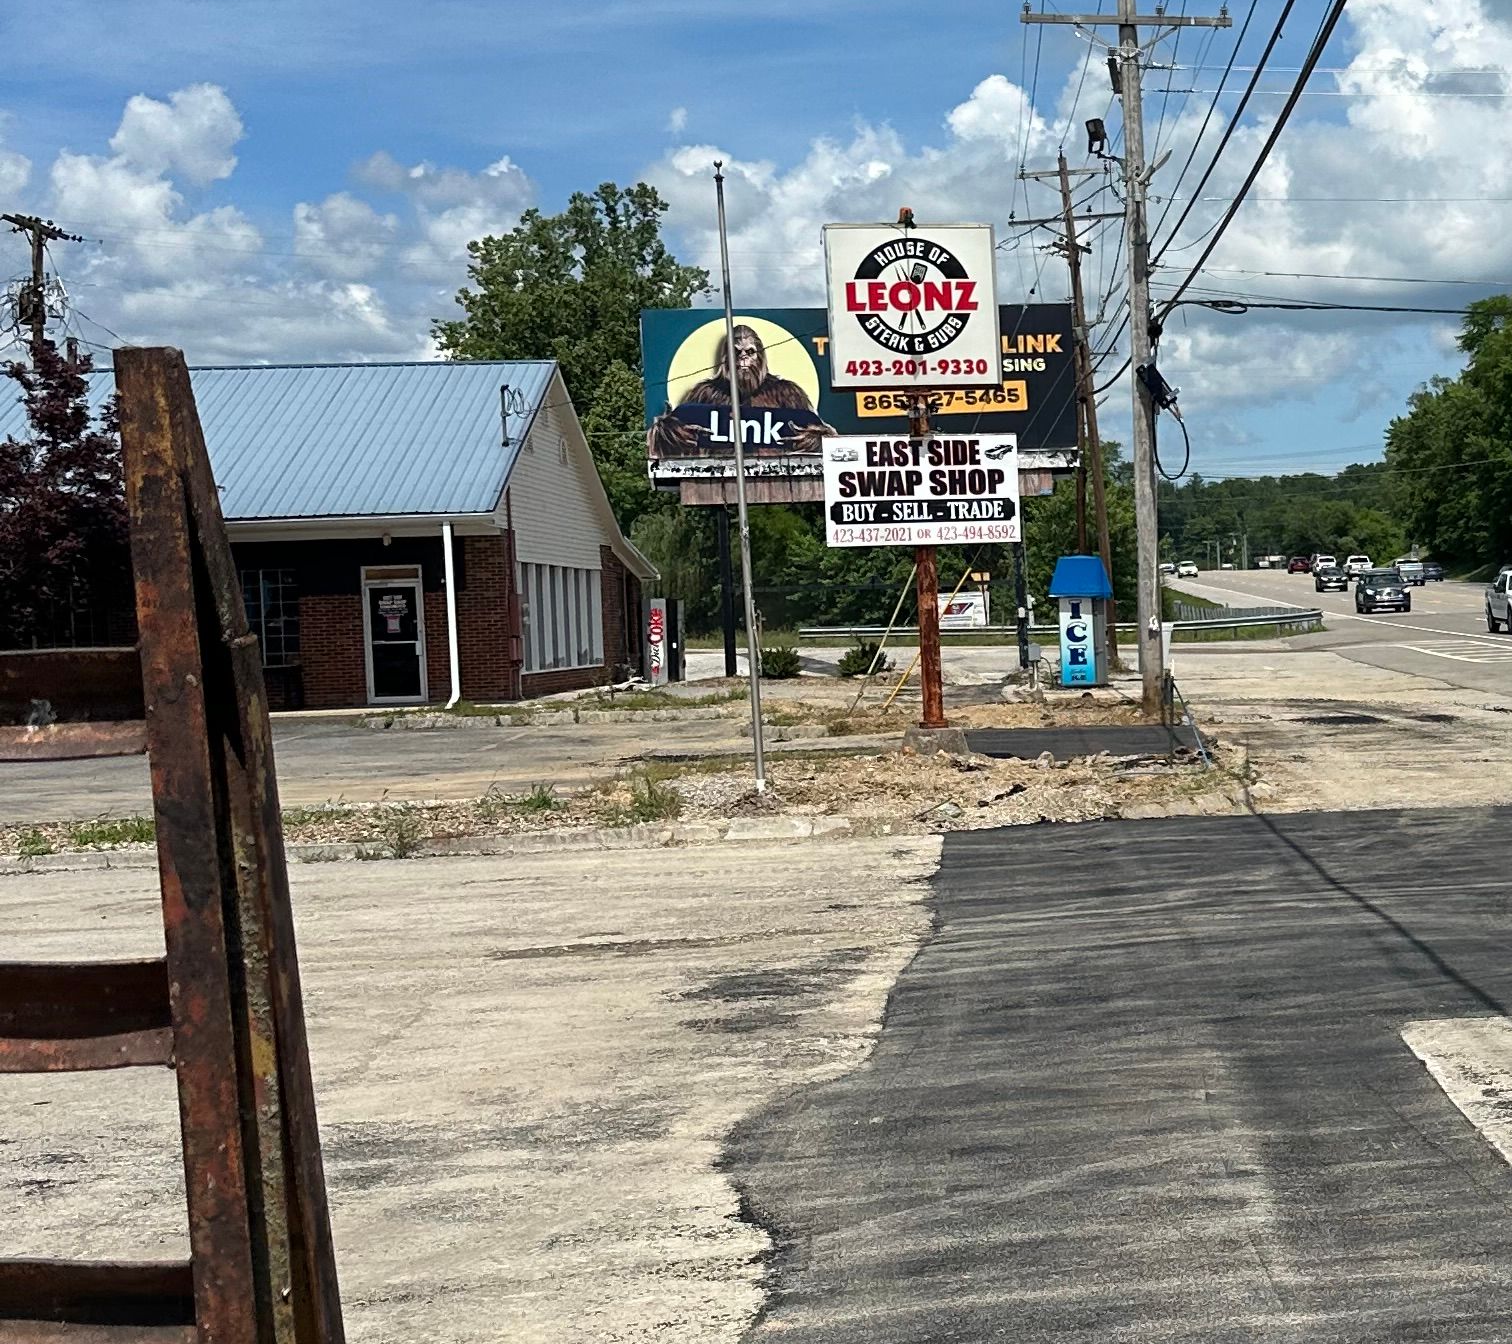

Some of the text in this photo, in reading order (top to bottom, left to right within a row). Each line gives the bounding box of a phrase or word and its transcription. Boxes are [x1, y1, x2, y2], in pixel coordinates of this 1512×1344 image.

[874, 241, 950, 266] HOUSE OF
[845, 281, 979, 312] LEONZ
[865, 317, 909, 351] STEAK
[914, 339, 924, 351] &
[927, 316, 963, 348] SUBS
[1001, 334, 1064, 354] LINK
[845, 358, 988, 376] 423-201-9330
[710, 410, 785, 445] Link
[866, 439, 981, 467] EAST SIDE
[838, 468, 1005, 498] SWAP SHOP
[842, 504, 878, 522] BUY
[892, 502, 932, 520] SELL
[947, 500, 1004, 519] TRADE
[832, 524, 1016, 543] 423-437-2021 OR 423-494-8592
[647, 608, 664, 645] Coke
[1066, 599, 1087, 665] ICE
